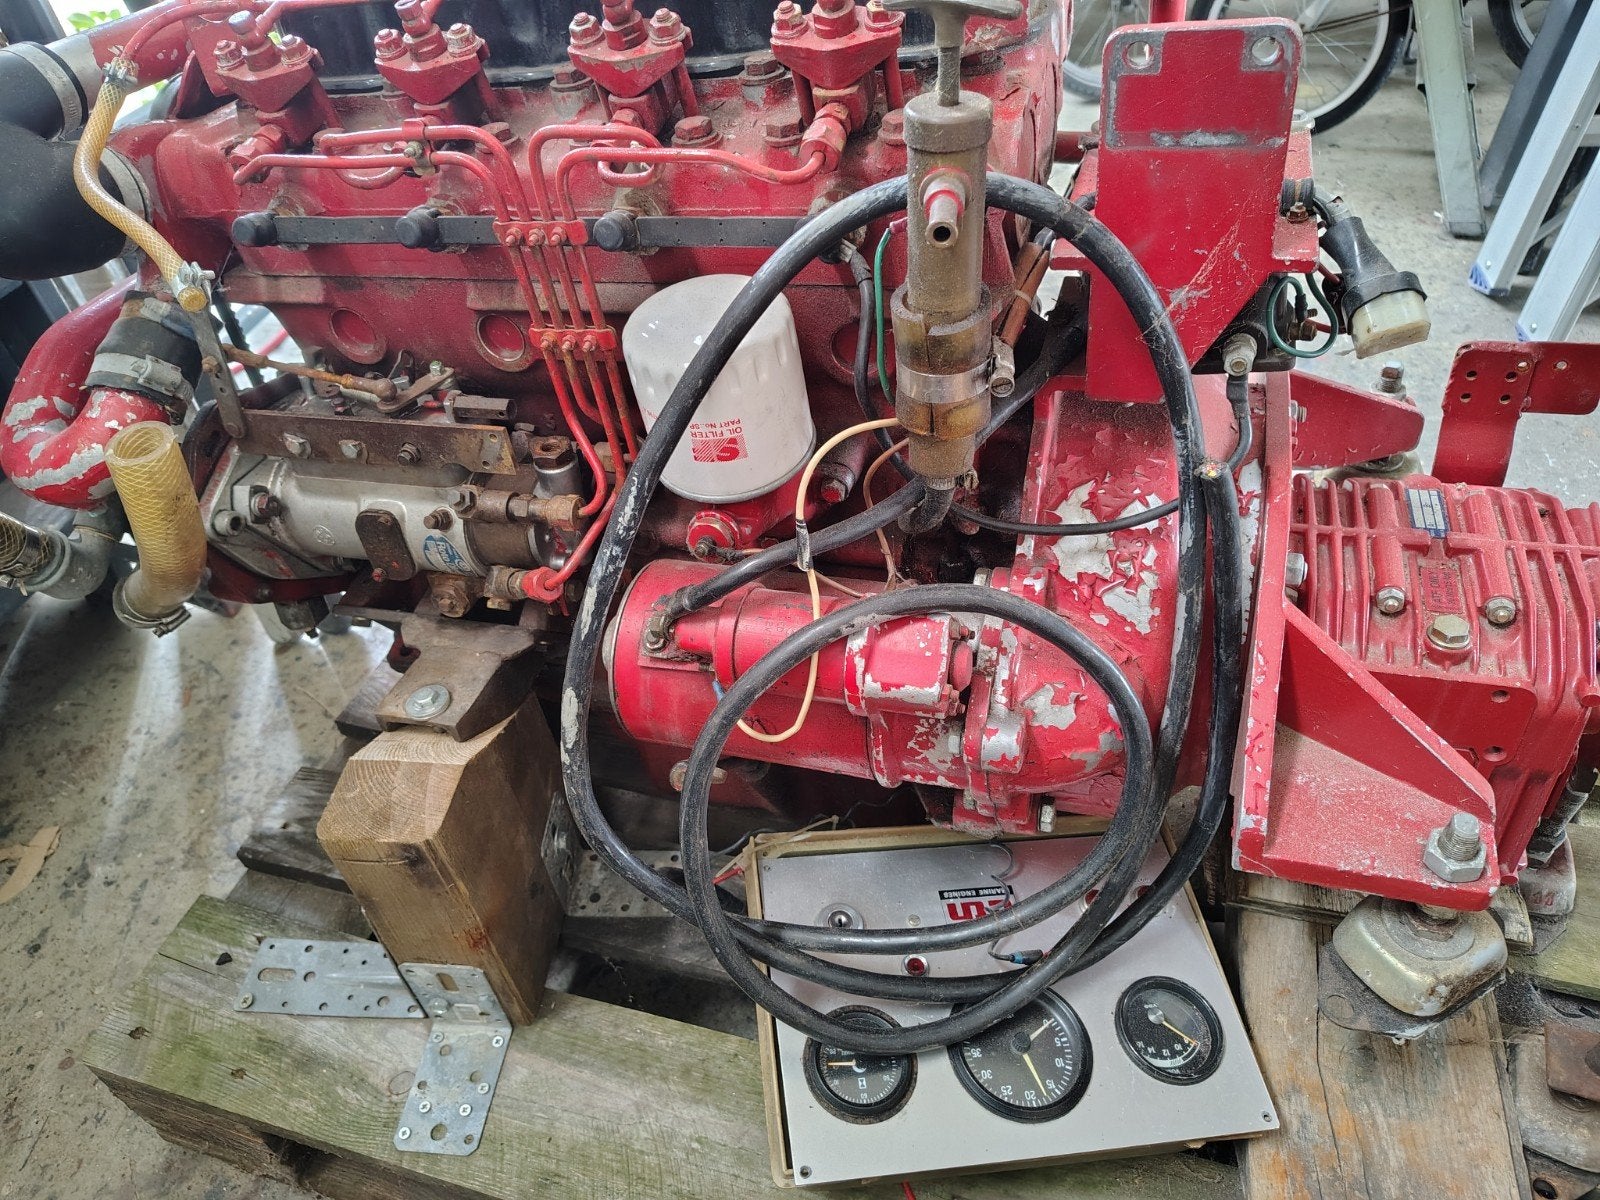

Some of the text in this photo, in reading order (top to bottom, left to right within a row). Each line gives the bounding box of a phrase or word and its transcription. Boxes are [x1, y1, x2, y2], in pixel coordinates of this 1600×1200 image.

[719, 418, 741, 428] PART
[690, 426, 743, 439] OIL FILTER
[943, 889, 977, 898] ENGINES
[1054, 1037, 1061, 1047] 5
[1135, 1040, 1145, 1049] 16
[1174, 1043, 1183, 1051] 10
[970, 1048, 982, 1058] 35
[1147, 1046, 1156, 1054] 14
[1161, 1049, 1171, 1057] 12
[1055, 1057, 1065, 1067] 10
[981, 1069, 993, 1080] 30
[1046, 1079, 1056, 1089] 15
[1001, 1085, 1013, 1096] 25
[1025, 1090, 1037, 1100] 20
